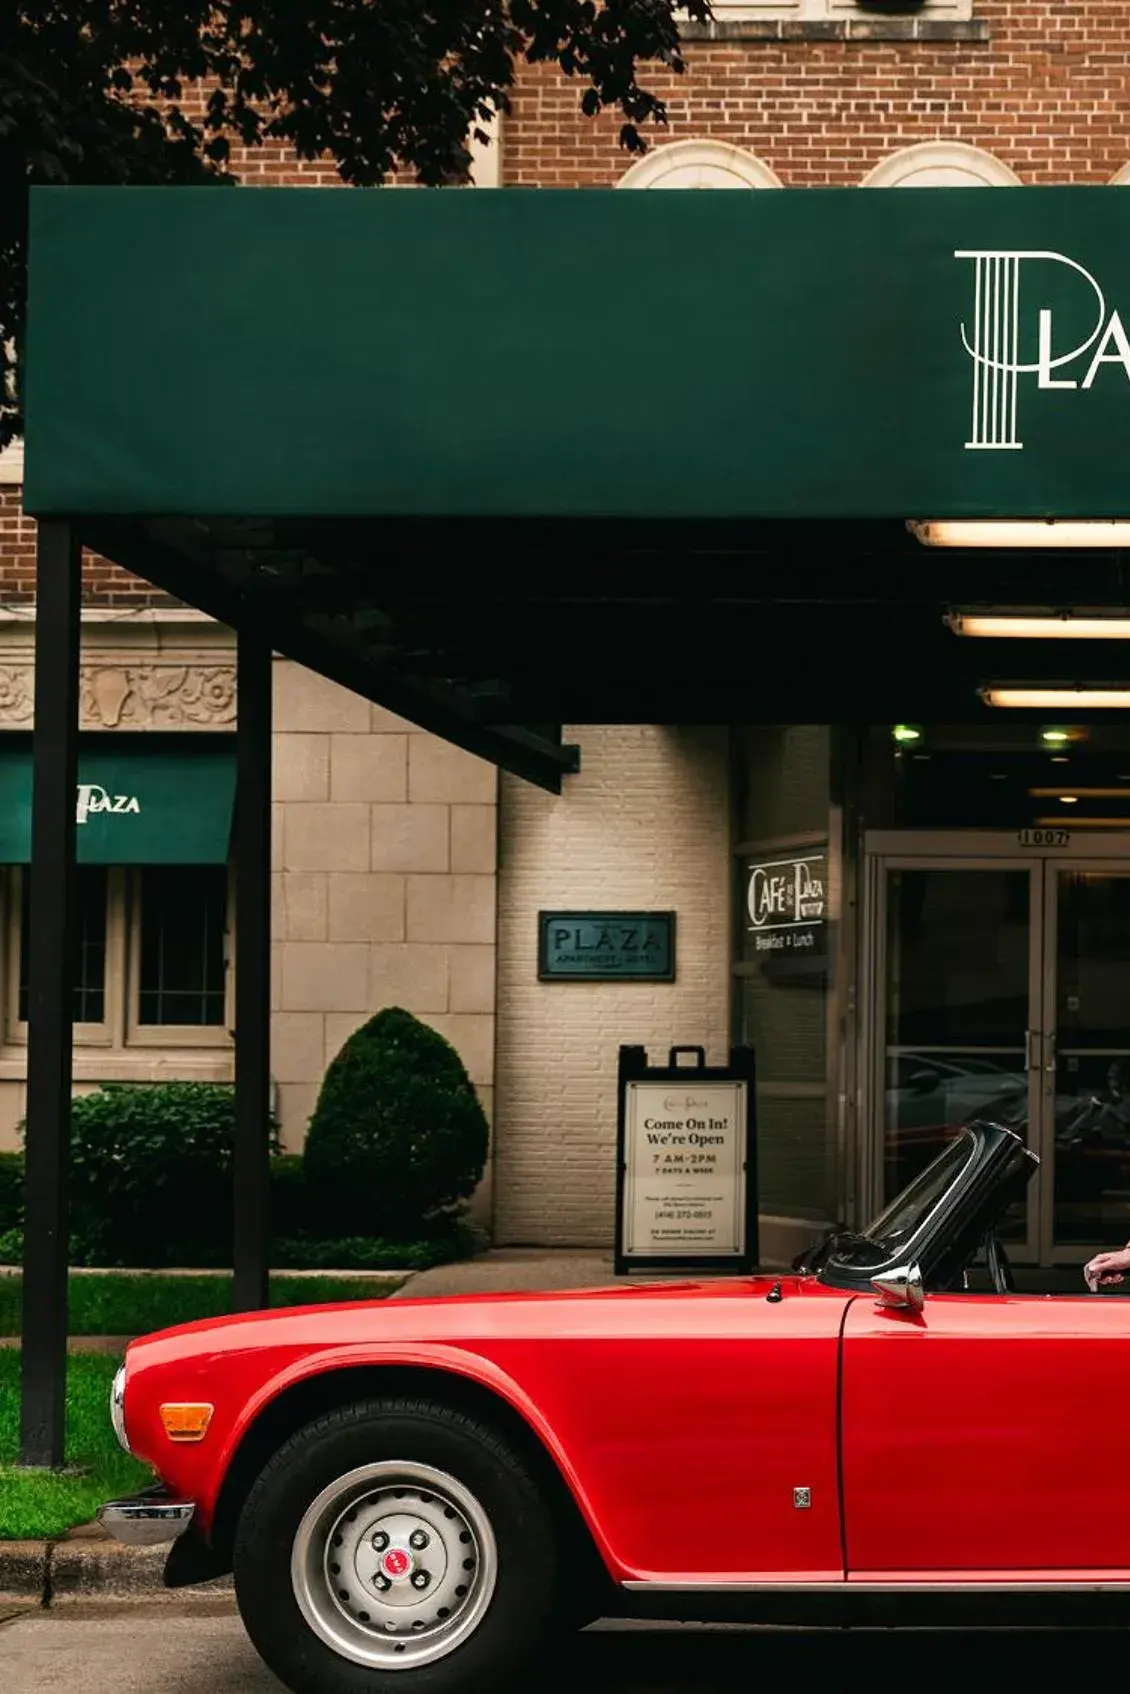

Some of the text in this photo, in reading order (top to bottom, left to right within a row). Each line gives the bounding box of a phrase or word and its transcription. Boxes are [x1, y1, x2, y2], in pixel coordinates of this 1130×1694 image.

[76, 784, 140, 824] PLAZA
[1024, 831, 1066, 843] 1007
[554, 928, 661, 950] PLAZA
[644, 1118, 728, 1130] Come On In!
[647, 1133, 725, 1148] We're Open
[653, 1154, 660, 1164] 7
